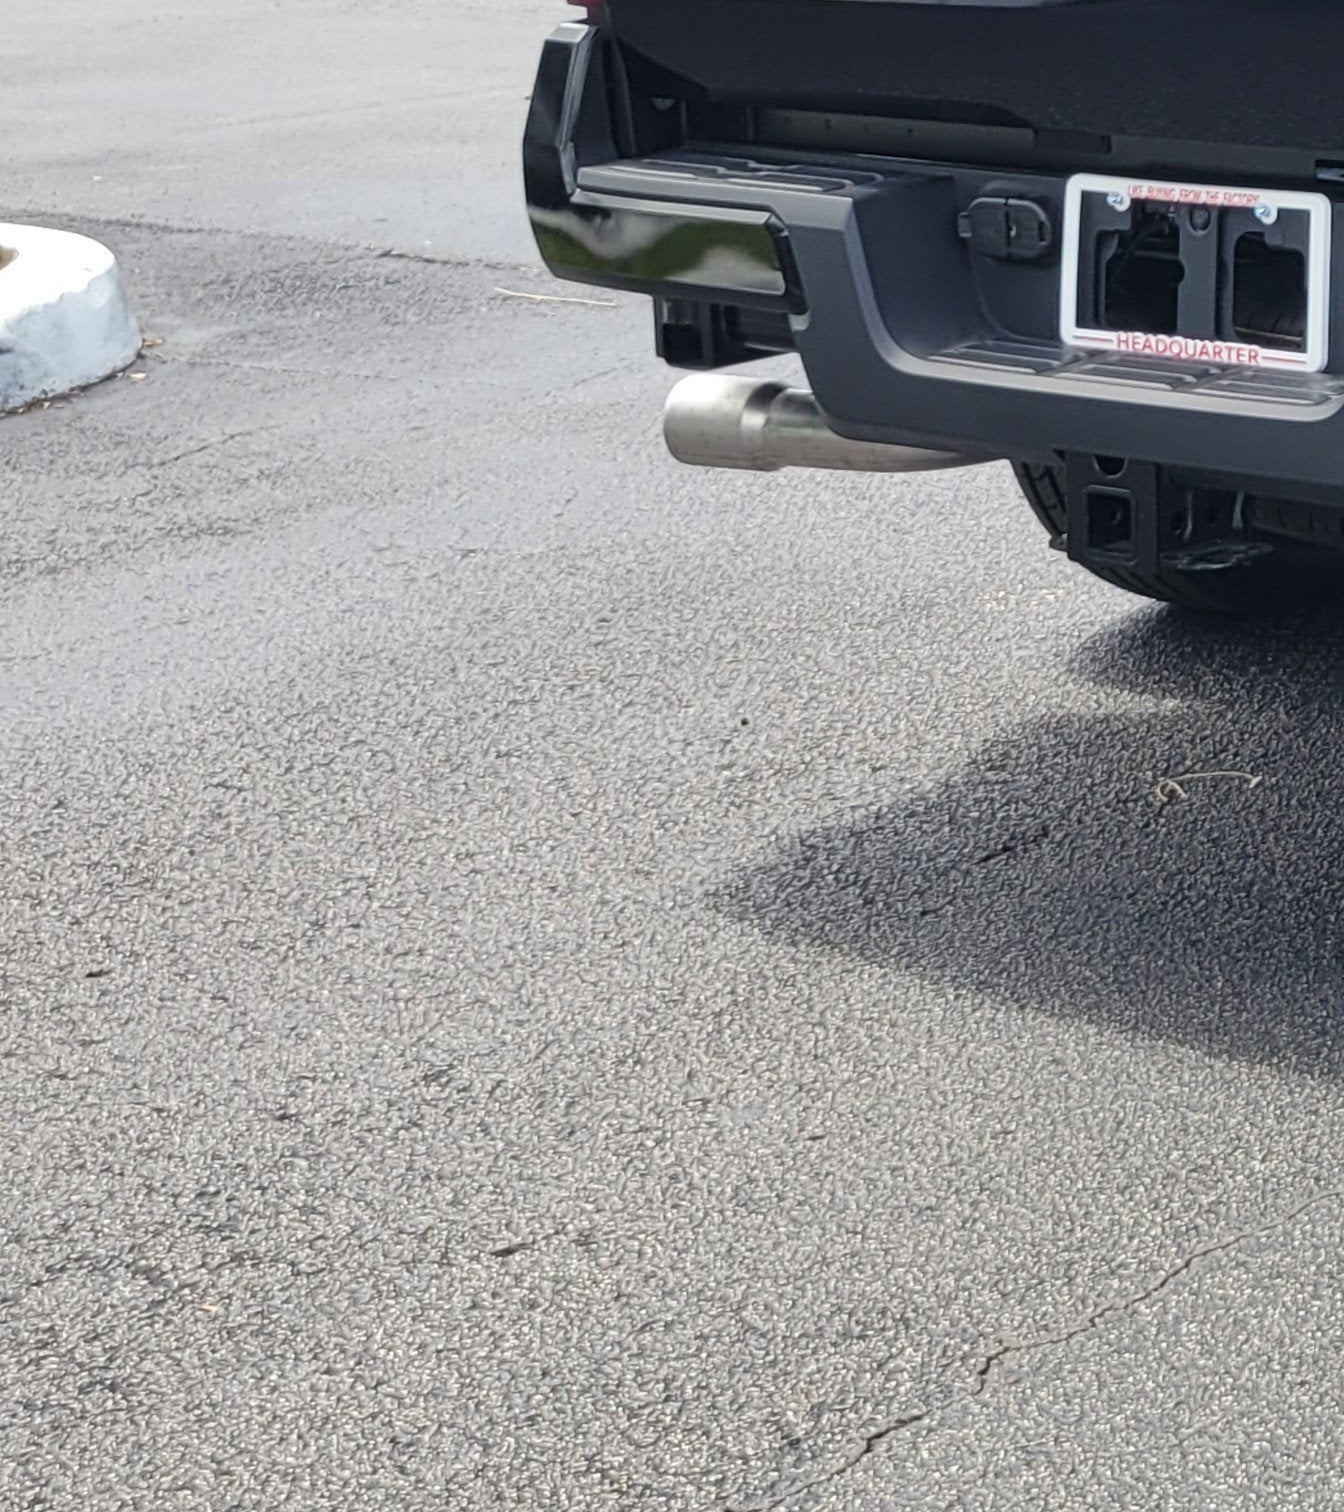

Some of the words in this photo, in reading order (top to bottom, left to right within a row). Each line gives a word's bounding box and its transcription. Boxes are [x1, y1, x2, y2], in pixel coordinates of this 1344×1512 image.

[1179, 189, 1202, 201] FROM
[1206, 191, 1220, 203] THE
[1116, 332, 1260, 363] HEADQUARTER
